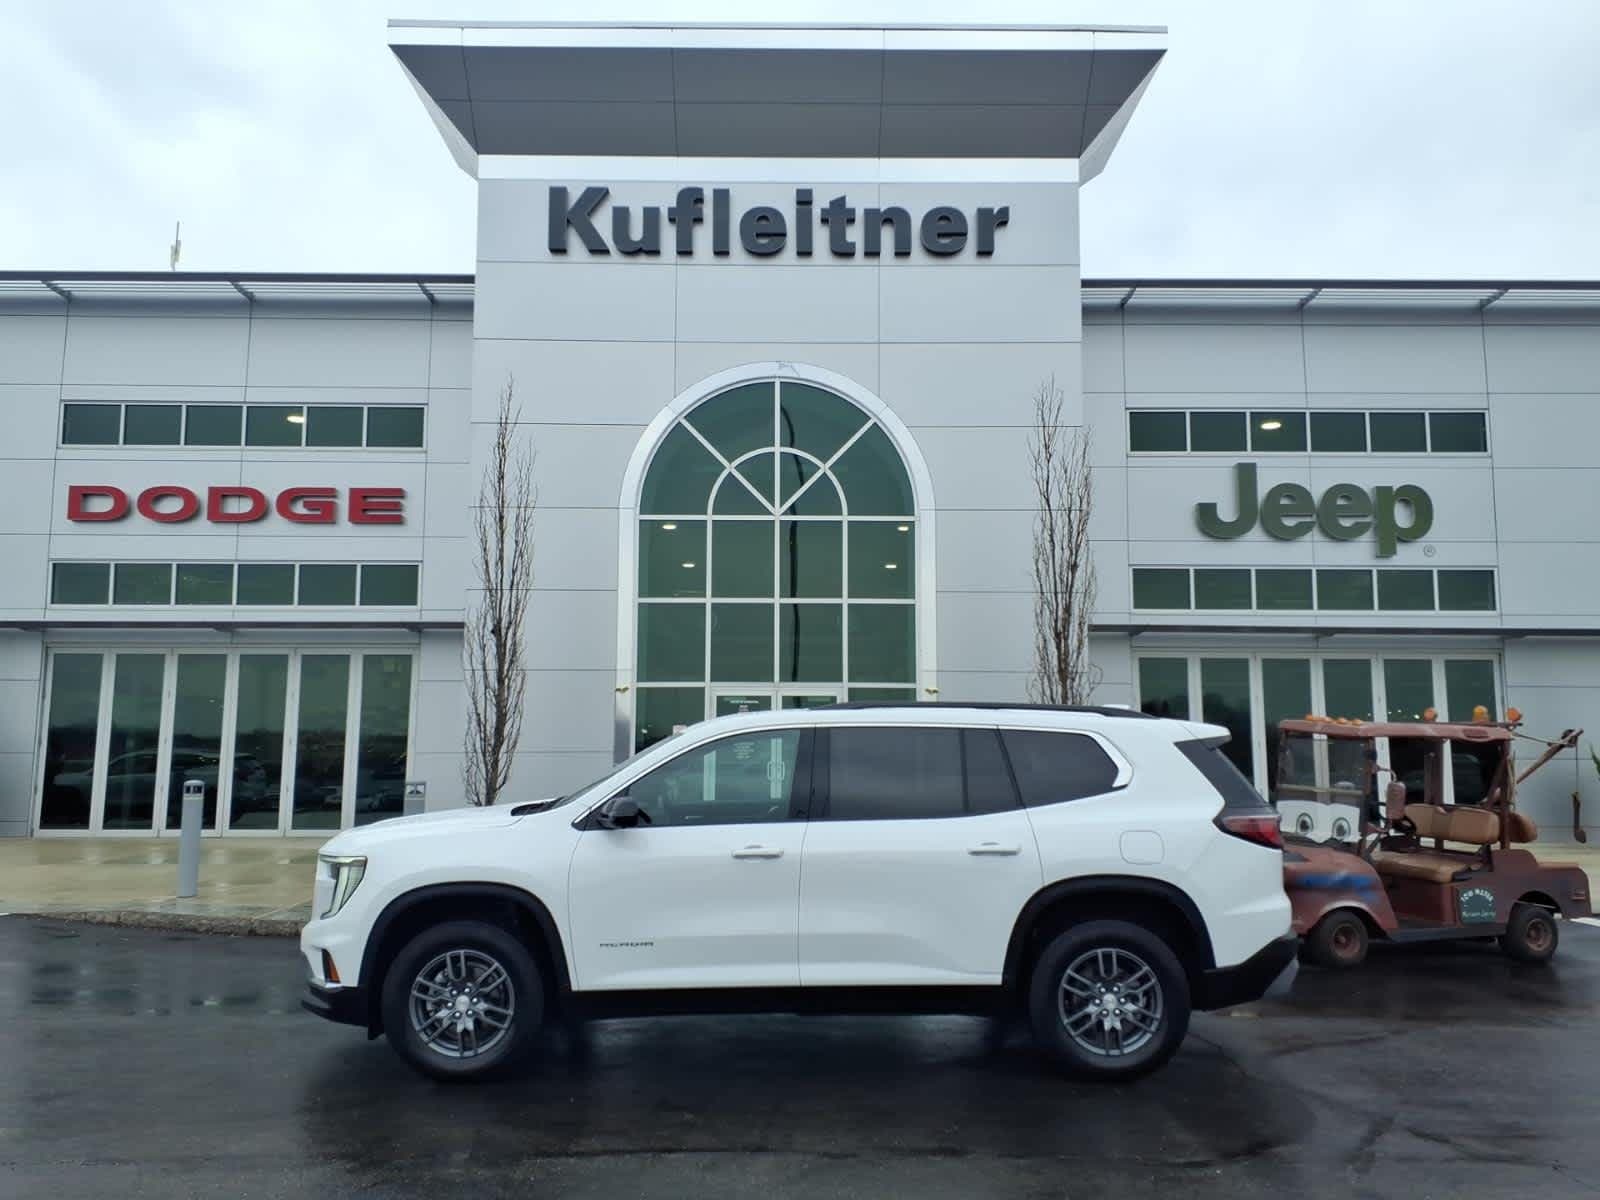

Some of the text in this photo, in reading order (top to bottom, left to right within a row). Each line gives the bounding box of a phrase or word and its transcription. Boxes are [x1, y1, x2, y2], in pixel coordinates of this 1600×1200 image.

[547, 186, 1010, 257] Kufleitner
[66, 485, 406, 525] DODGE
[1195, 462, 1434, 559] Jeep
